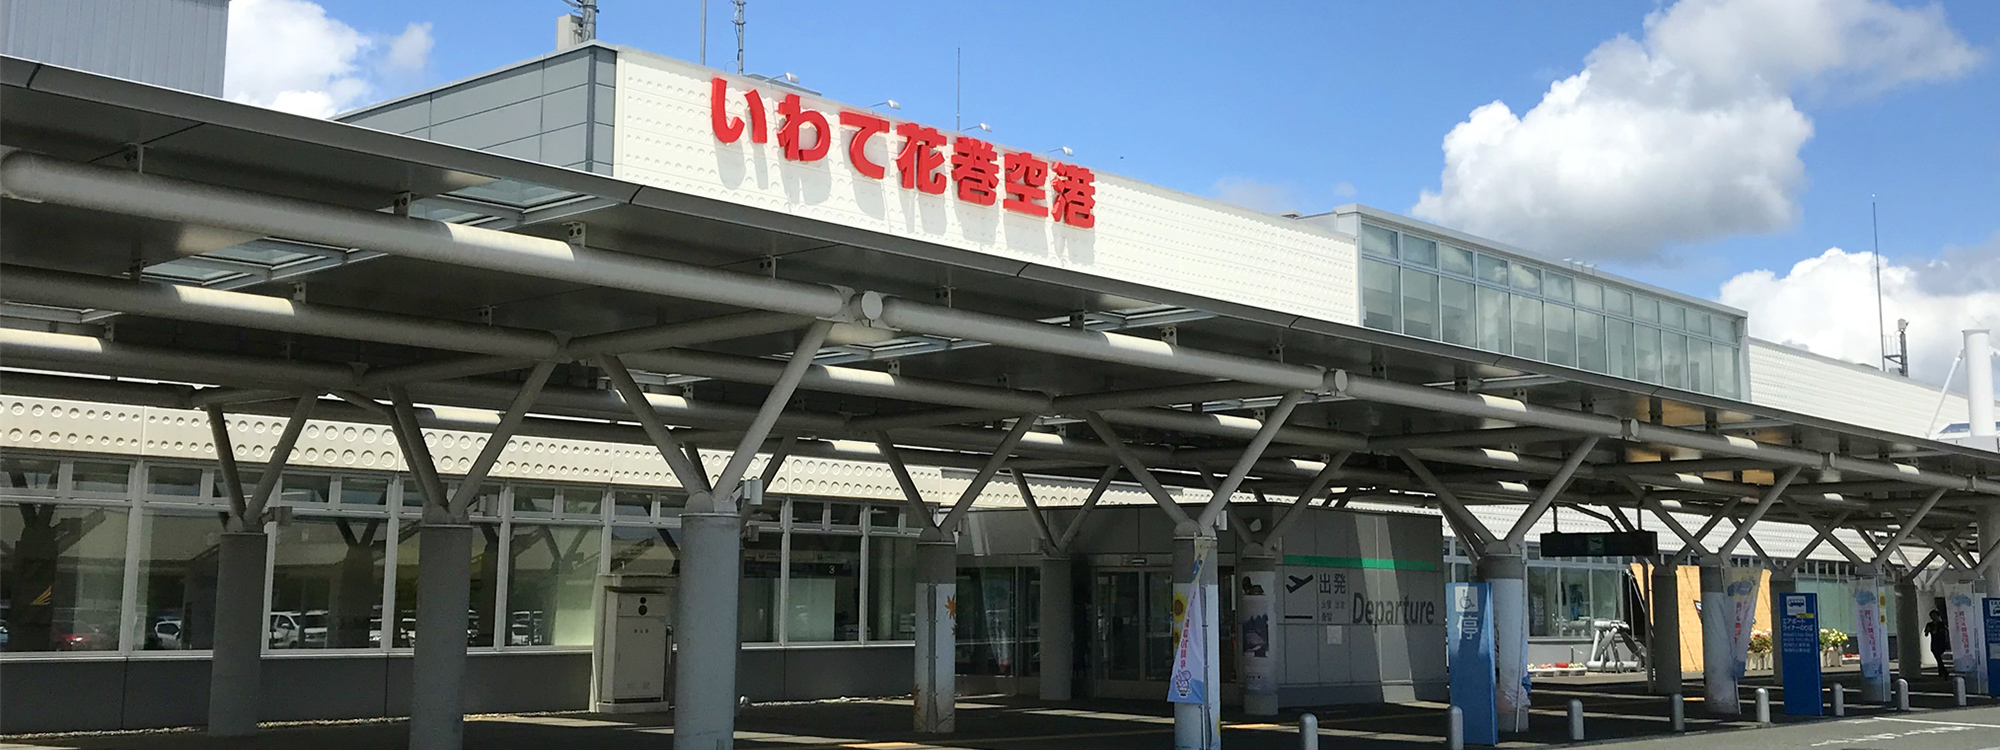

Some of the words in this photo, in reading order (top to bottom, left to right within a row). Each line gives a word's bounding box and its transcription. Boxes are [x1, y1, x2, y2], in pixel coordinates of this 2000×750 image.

[711, 77, 1096, 229] いわて花巻空港
[828, 565, 836, 574] 3
[1319, 573, 1347, 595] 出発
[1352, 592, 1435, 632] Departure
[1456, 615, 1479, 640] 停
